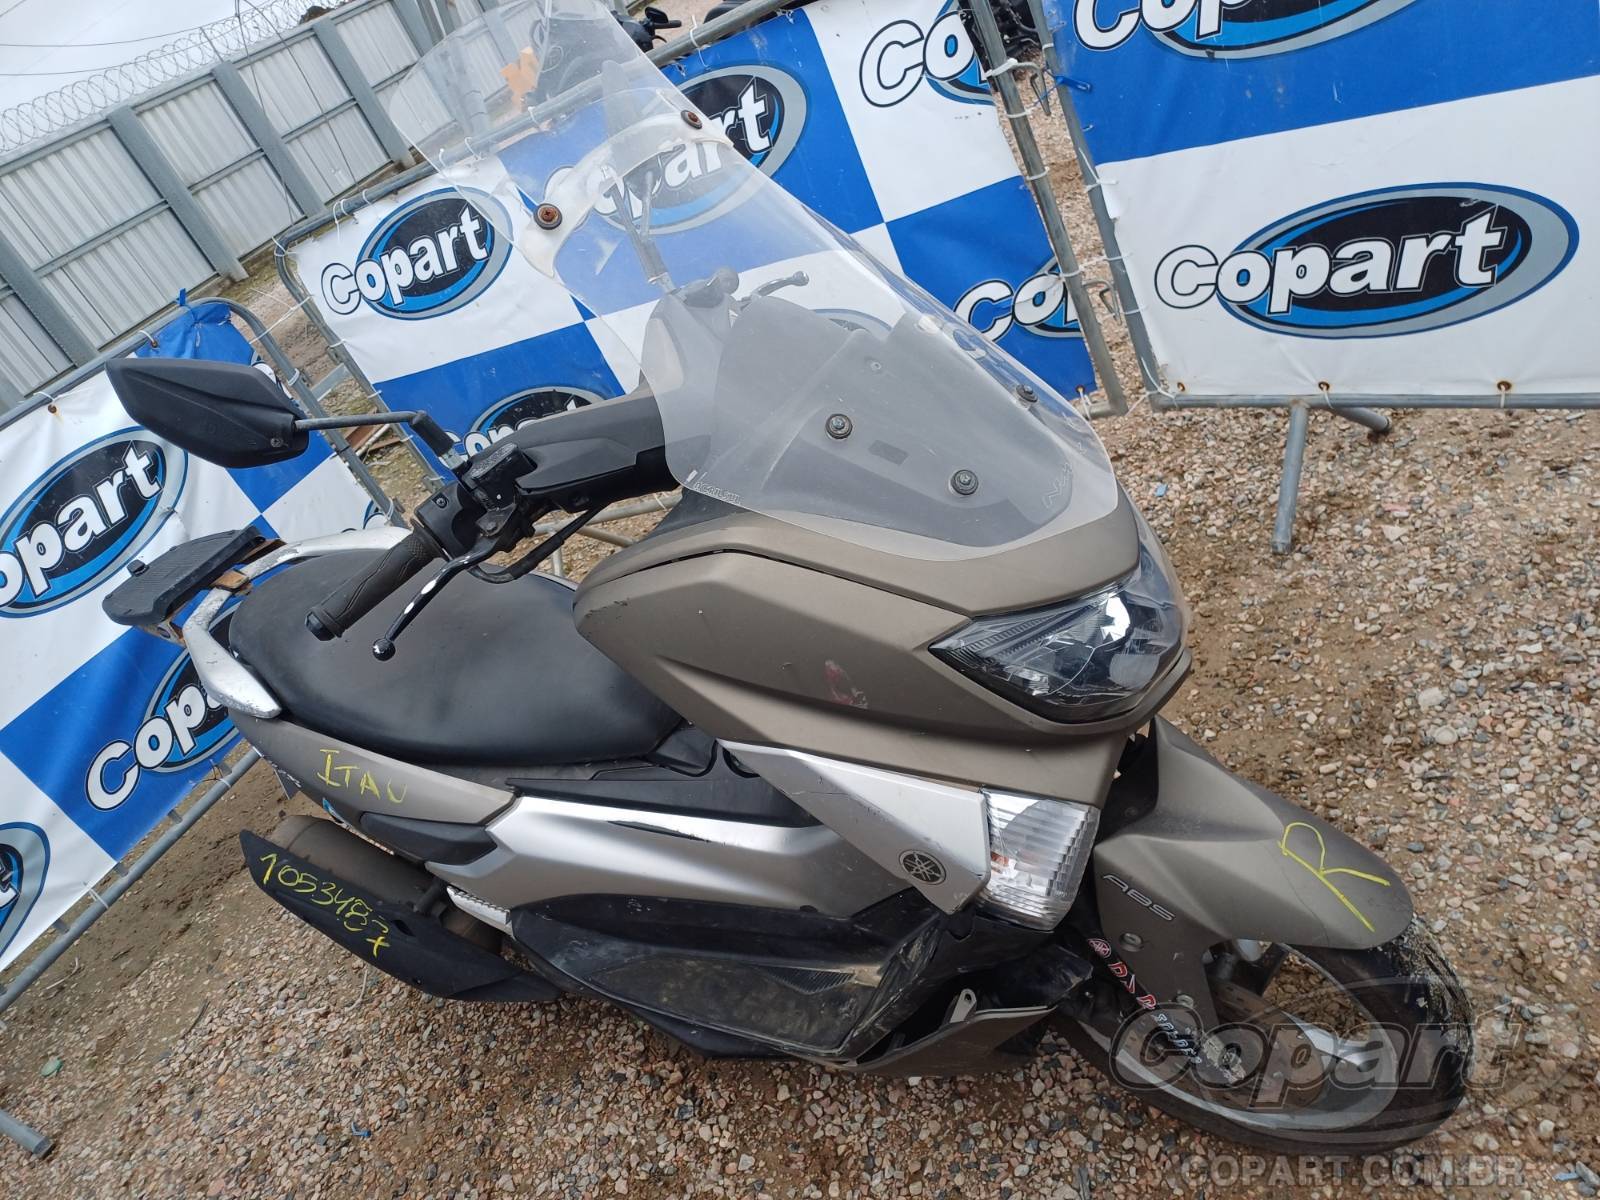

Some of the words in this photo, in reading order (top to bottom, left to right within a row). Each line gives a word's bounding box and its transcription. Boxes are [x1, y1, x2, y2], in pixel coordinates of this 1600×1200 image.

[859, 9, 991, 109] Co
[320, 203, 490, 316] Copart
[1154, 203, 1508, 317] Copart
[953, 278, 1080, 343] Co
[85, 681, 225, 811] Cop
[316, 749, 408, 804] ITAU
[1103, 873, 1176, 922] ABS
